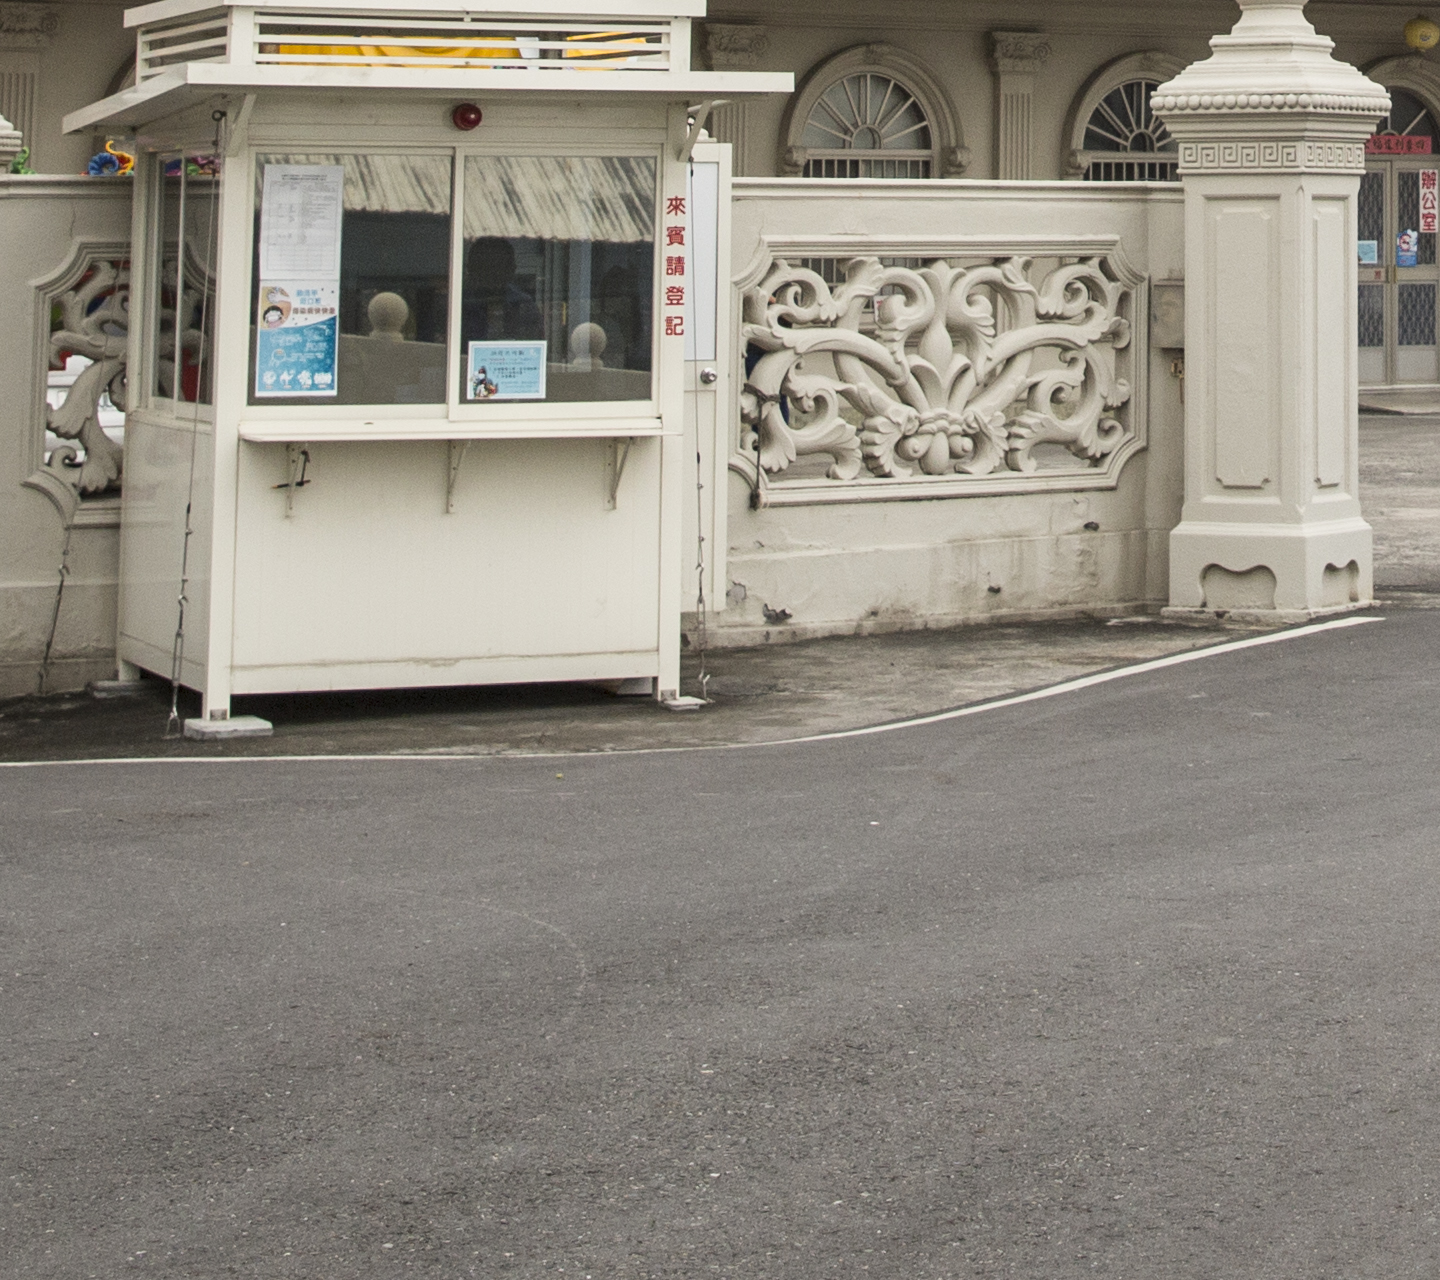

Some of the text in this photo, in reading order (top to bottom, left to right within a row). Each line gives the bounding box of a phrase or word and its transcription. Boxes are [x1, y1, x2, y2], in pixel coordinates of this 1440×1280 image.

[1420, 170, 1438, 233] 辦公室
[665, 193, 687, 339] 來賓請登記
